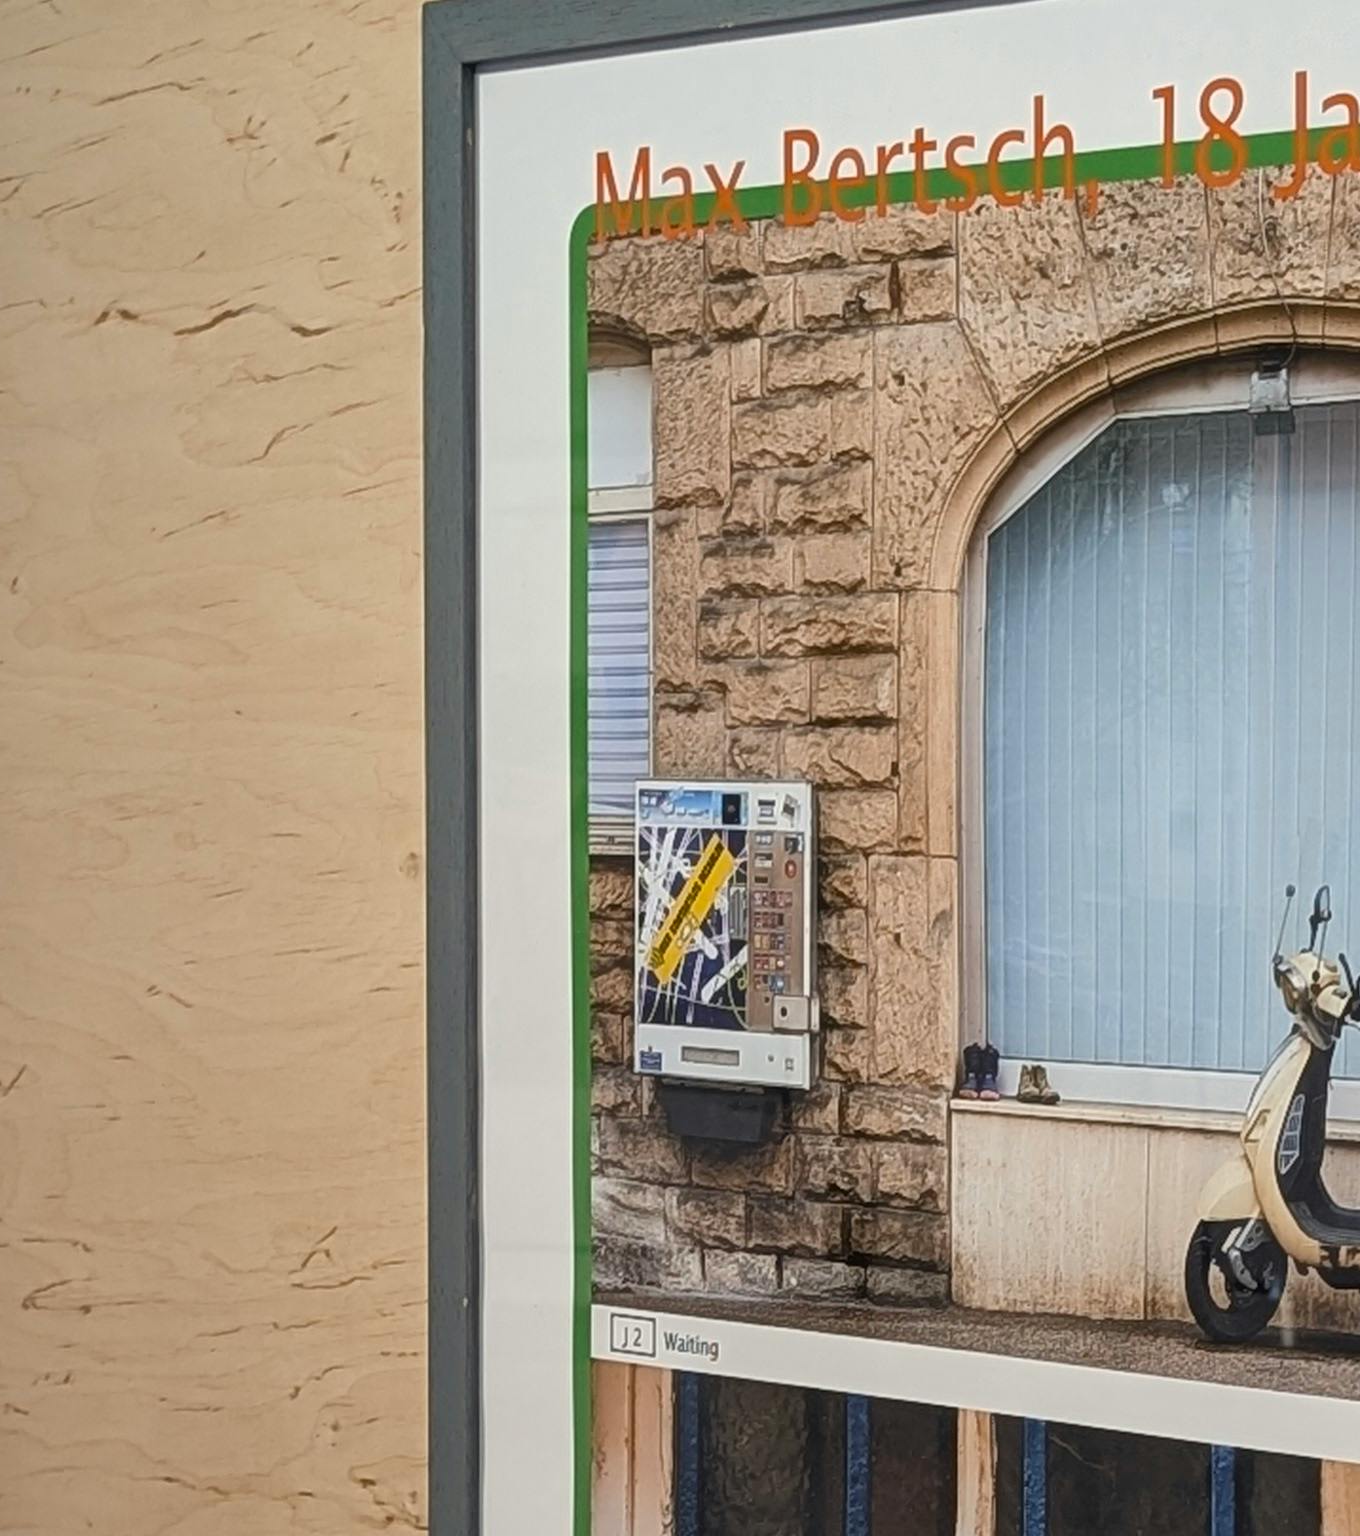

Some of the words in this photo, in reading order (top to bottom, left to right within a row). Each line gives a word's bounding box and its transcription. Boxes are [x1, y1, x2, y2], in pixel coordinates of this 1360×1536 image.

[593, 144, 752, 243] Max
[783, 94, 1099, 227] Bertsch,
[1152, 76, 1249, 189] 18
[663, 1331, 720, 1361] Waiting
